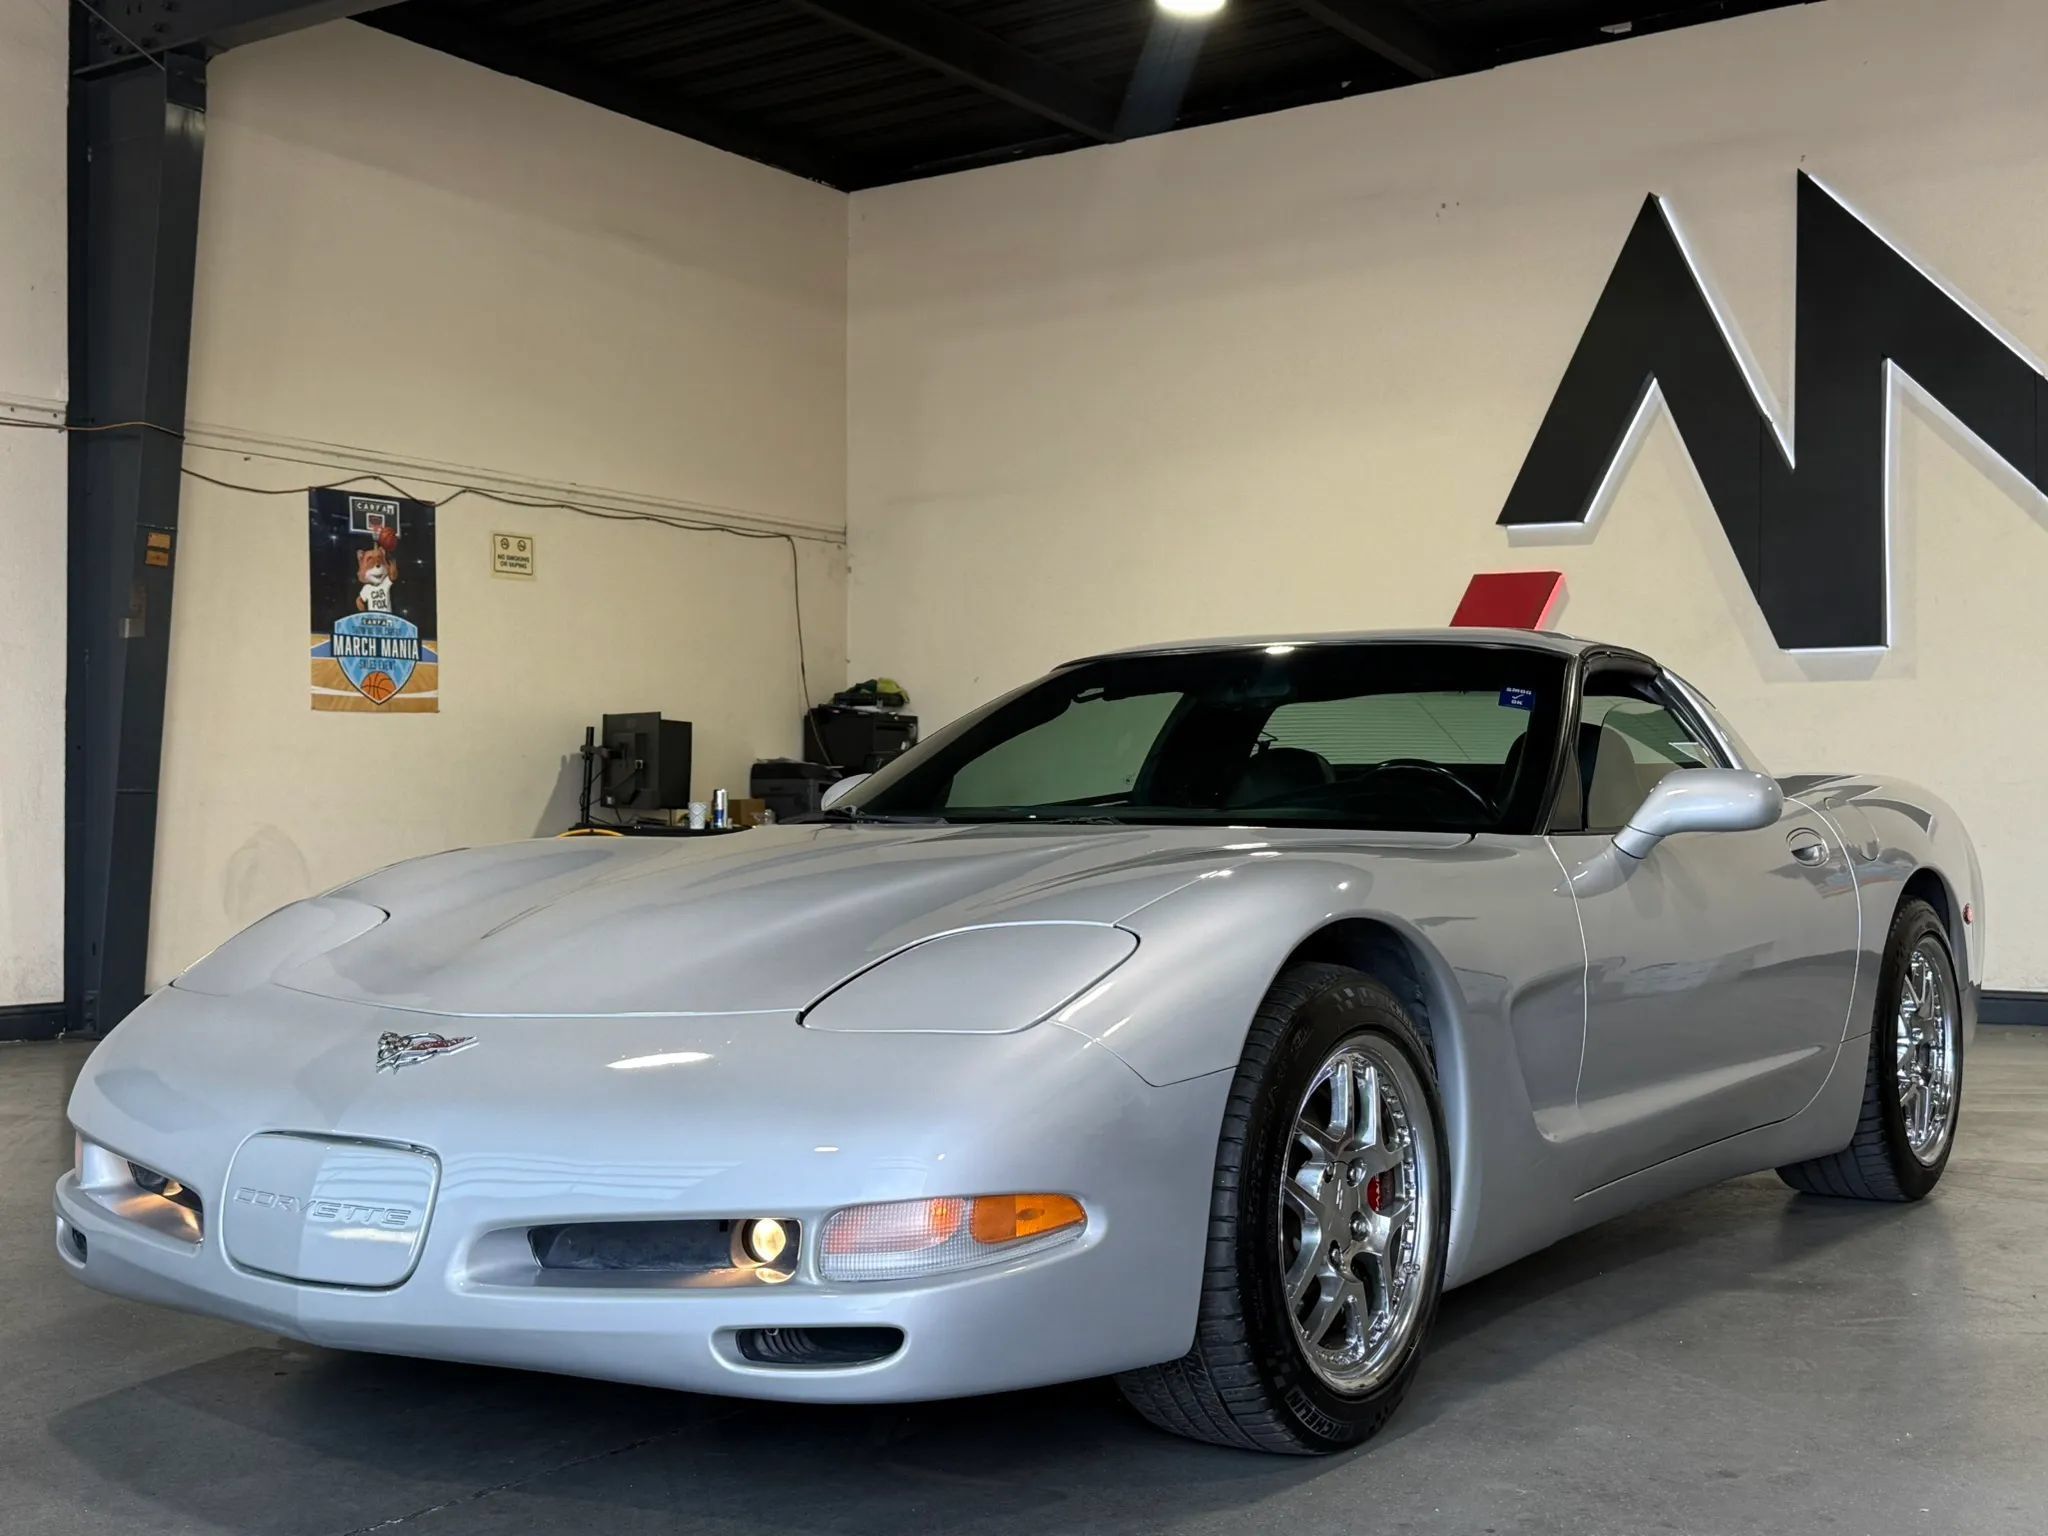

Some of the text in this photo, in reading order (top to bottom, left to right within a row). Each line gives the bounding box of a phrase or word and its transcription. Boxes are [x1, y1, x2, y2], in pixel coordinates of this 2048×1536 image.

[370, 589, 386, 600] CAR
[372, 599, 387, 609] FOX
[333, 634, 420, 661] MARCH MANIA
[1506, 687, 1532, 695] SMOG
[232, 1187, 412, 1226] CORVETTE
